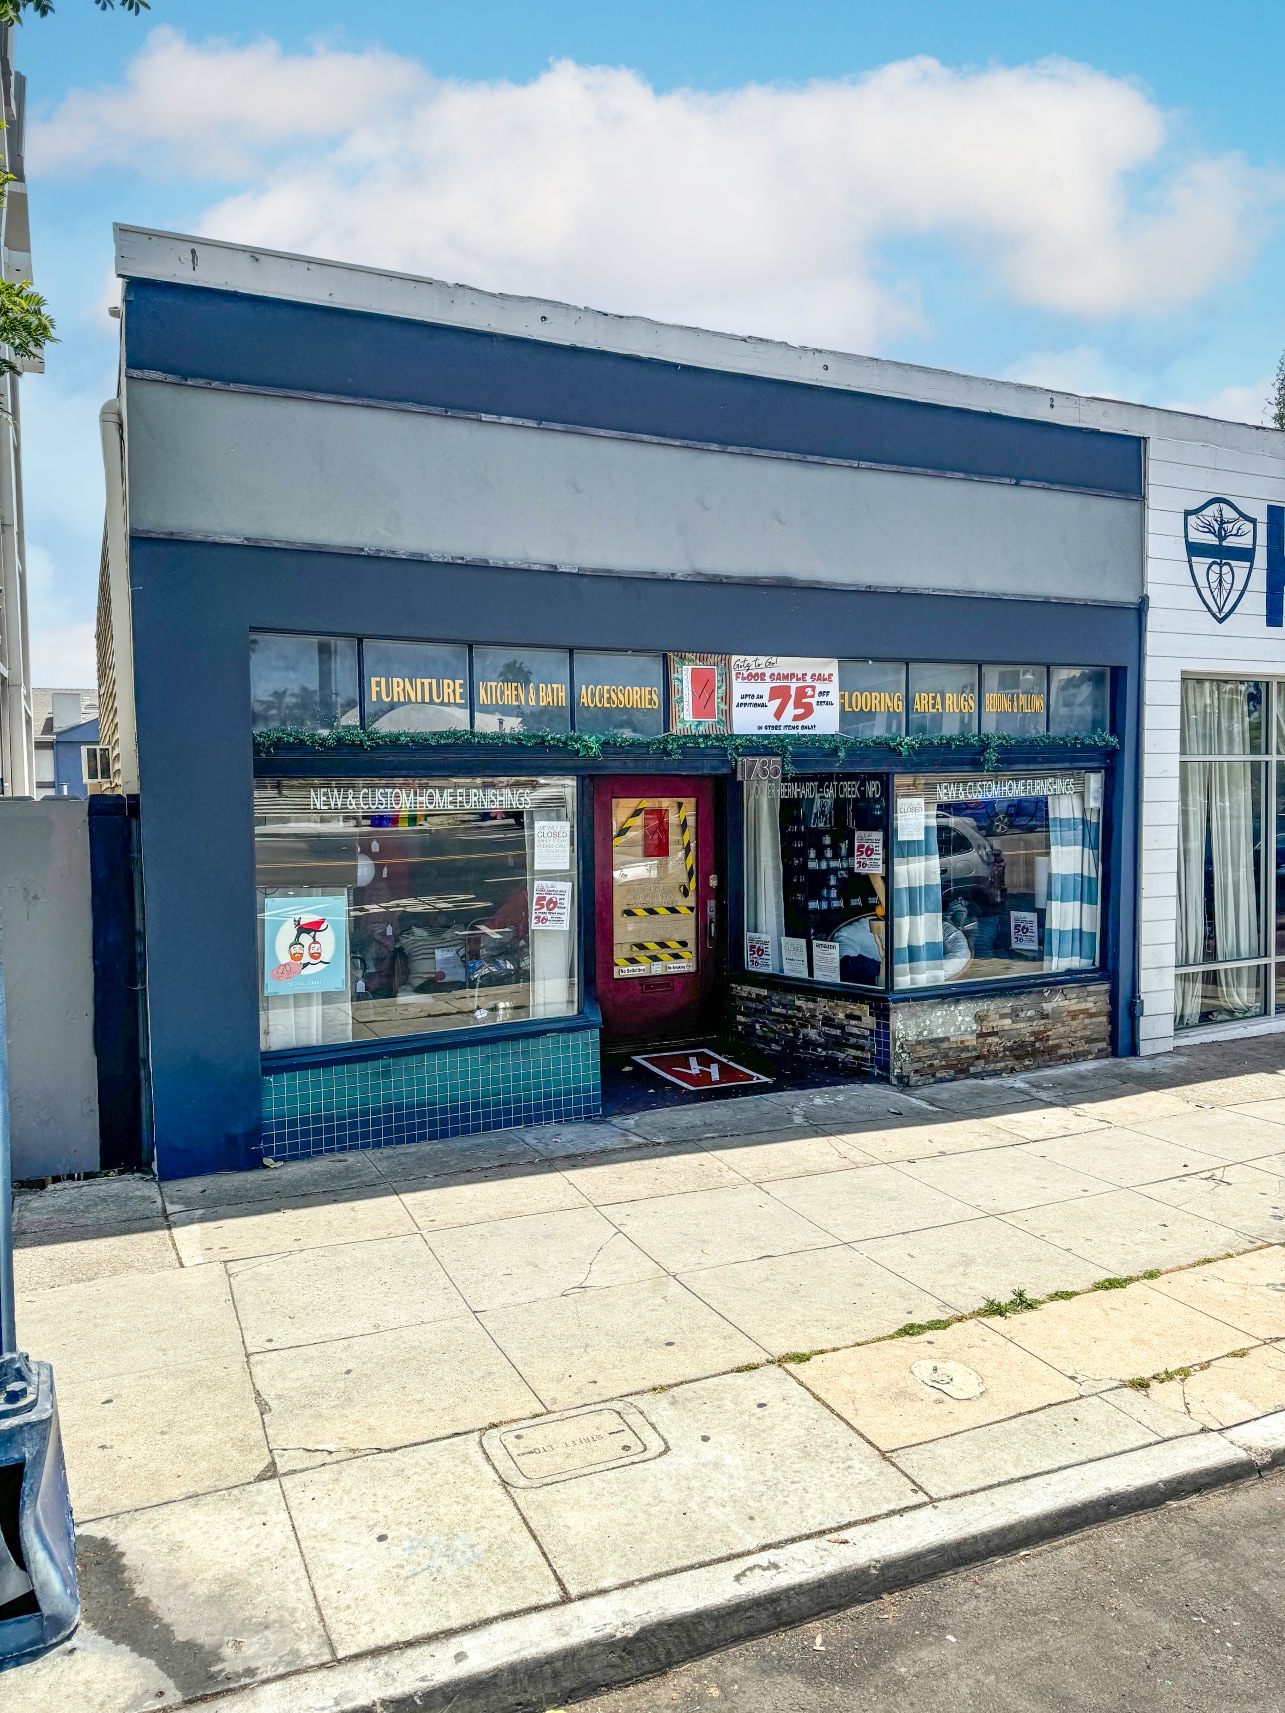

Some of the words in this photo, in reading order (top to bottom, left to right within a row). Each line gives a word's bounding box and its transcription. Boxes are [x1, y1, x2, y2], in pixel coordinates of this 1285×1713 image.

[735, 672, 767, 681] FLOOR
[769, 672, 807, 682] SAMPLE
[810, 673, 834, 682] SALE
[370, 677, 465, 704] FURNITURE
[479, 681, 525, 705] KITCHEN
[528, 683, 536, 706] &
[539, 683, 566, 707] BATH
[580, 684, 658, 709] ACCESSORIES
[839, 691, 903, 713] FLOORING
[914, 692, 942, 713] AREA
[945, 693, 975, 713] RUGS
[985, 693, 1011, 712] BEDDING
[1013, 693, 1018, 713] &
[1019, 693, 1044, 713] PILLOWS
[743, 757, 781, 780] 1735
[310, 788, 343, 810] NEW
[347, 789, 357, 810] &
[360, 788, 414, 810] CUSTOM
[417, 788, 455, 809] HOME
[456, 788, 532, 809] FURNISHINGS
[780, 782, 819, 799] BERNHARDT
[823, 781, 838, 798] GAT
[839, 781, 860, 798] CREEK
[865, 781, 881, 798] NPD
[937, 782, 957, 800] NEW
[958, 782, 966, 799] &
[966, 781, 1002, 799] CUSTOM
[1002, 779, 1025, 797] HOME
[1026, 778, 1074, 796] FURNISHINGS
[900, 806, 922, 814] CLOSED
[537, 831, 567, 839] CLOSED
[815, 942, 837, 950] amazon
[564, 1434, 604, 1448] STREET
